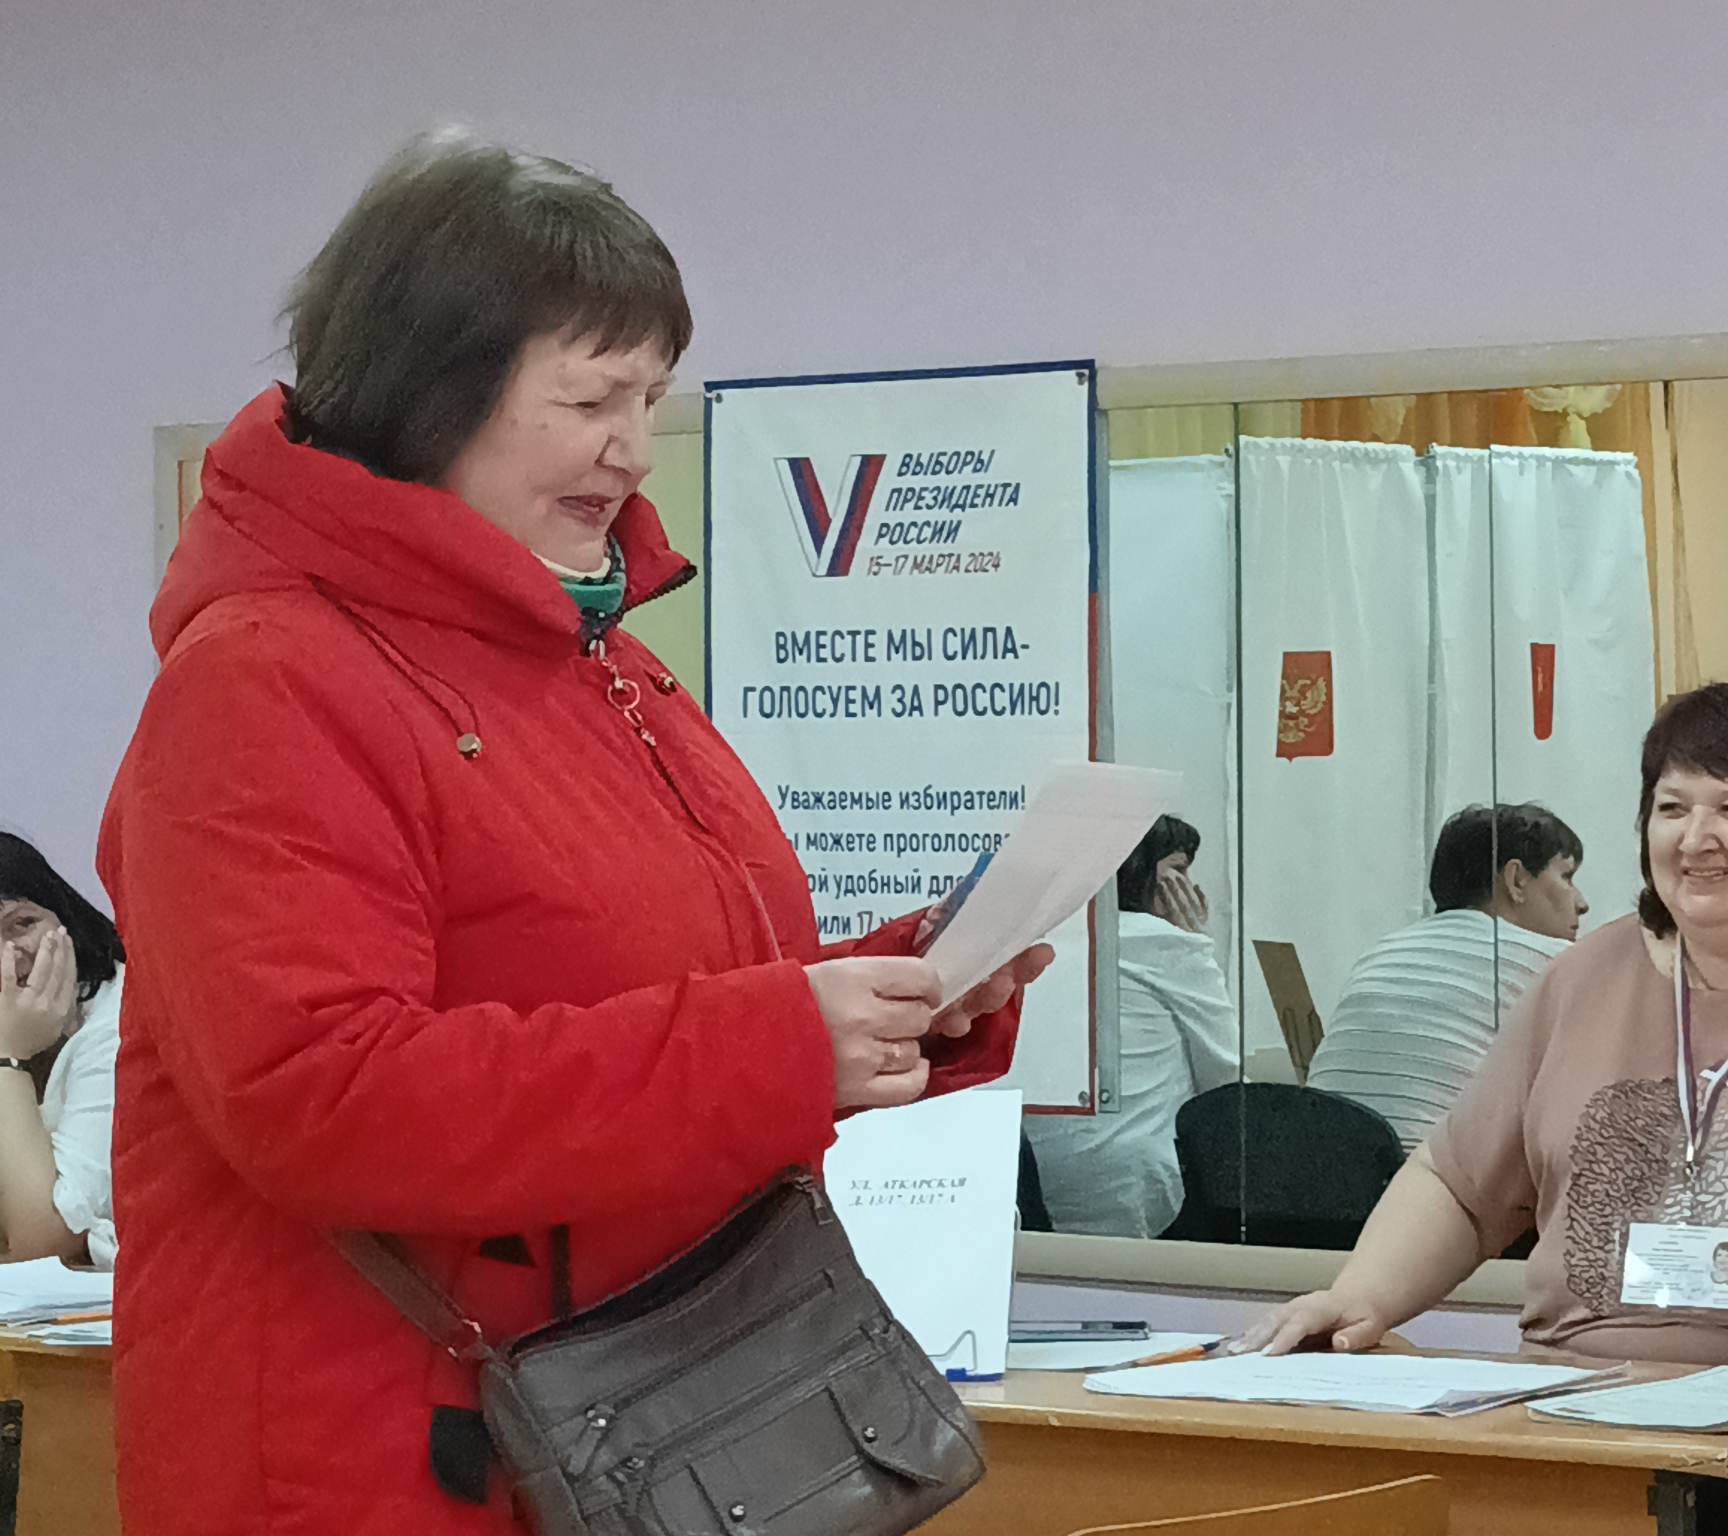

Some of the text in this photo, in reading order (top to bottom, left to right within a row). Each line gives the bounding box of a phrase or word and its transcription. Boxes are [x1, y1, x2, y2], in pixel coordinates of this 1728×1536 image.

[896, 449, 996, 478] ВЫБОРЫ
[884, 482, 1021, 513] ПРЕЗИДЕНТА
[873, 519, 963, 546] РОССИИ
[908, 552, 961, 576] МАРТА
[963, 550, 1002, 574] 2024
[774, 629, 878, 664] ВМЕСТЕ
[886, 629, 934, 662] МЫ
[742, 681, 1061, 719] ГОЛОСУЕМ ЗА РОССИЮ!
[777, 783, 1027, 816] Уважаемые избиратели!
[805, 832, 877, 853] можете
[883, 832, 1010, 858] проголосов
[832, 868, 922, 900] удобный
